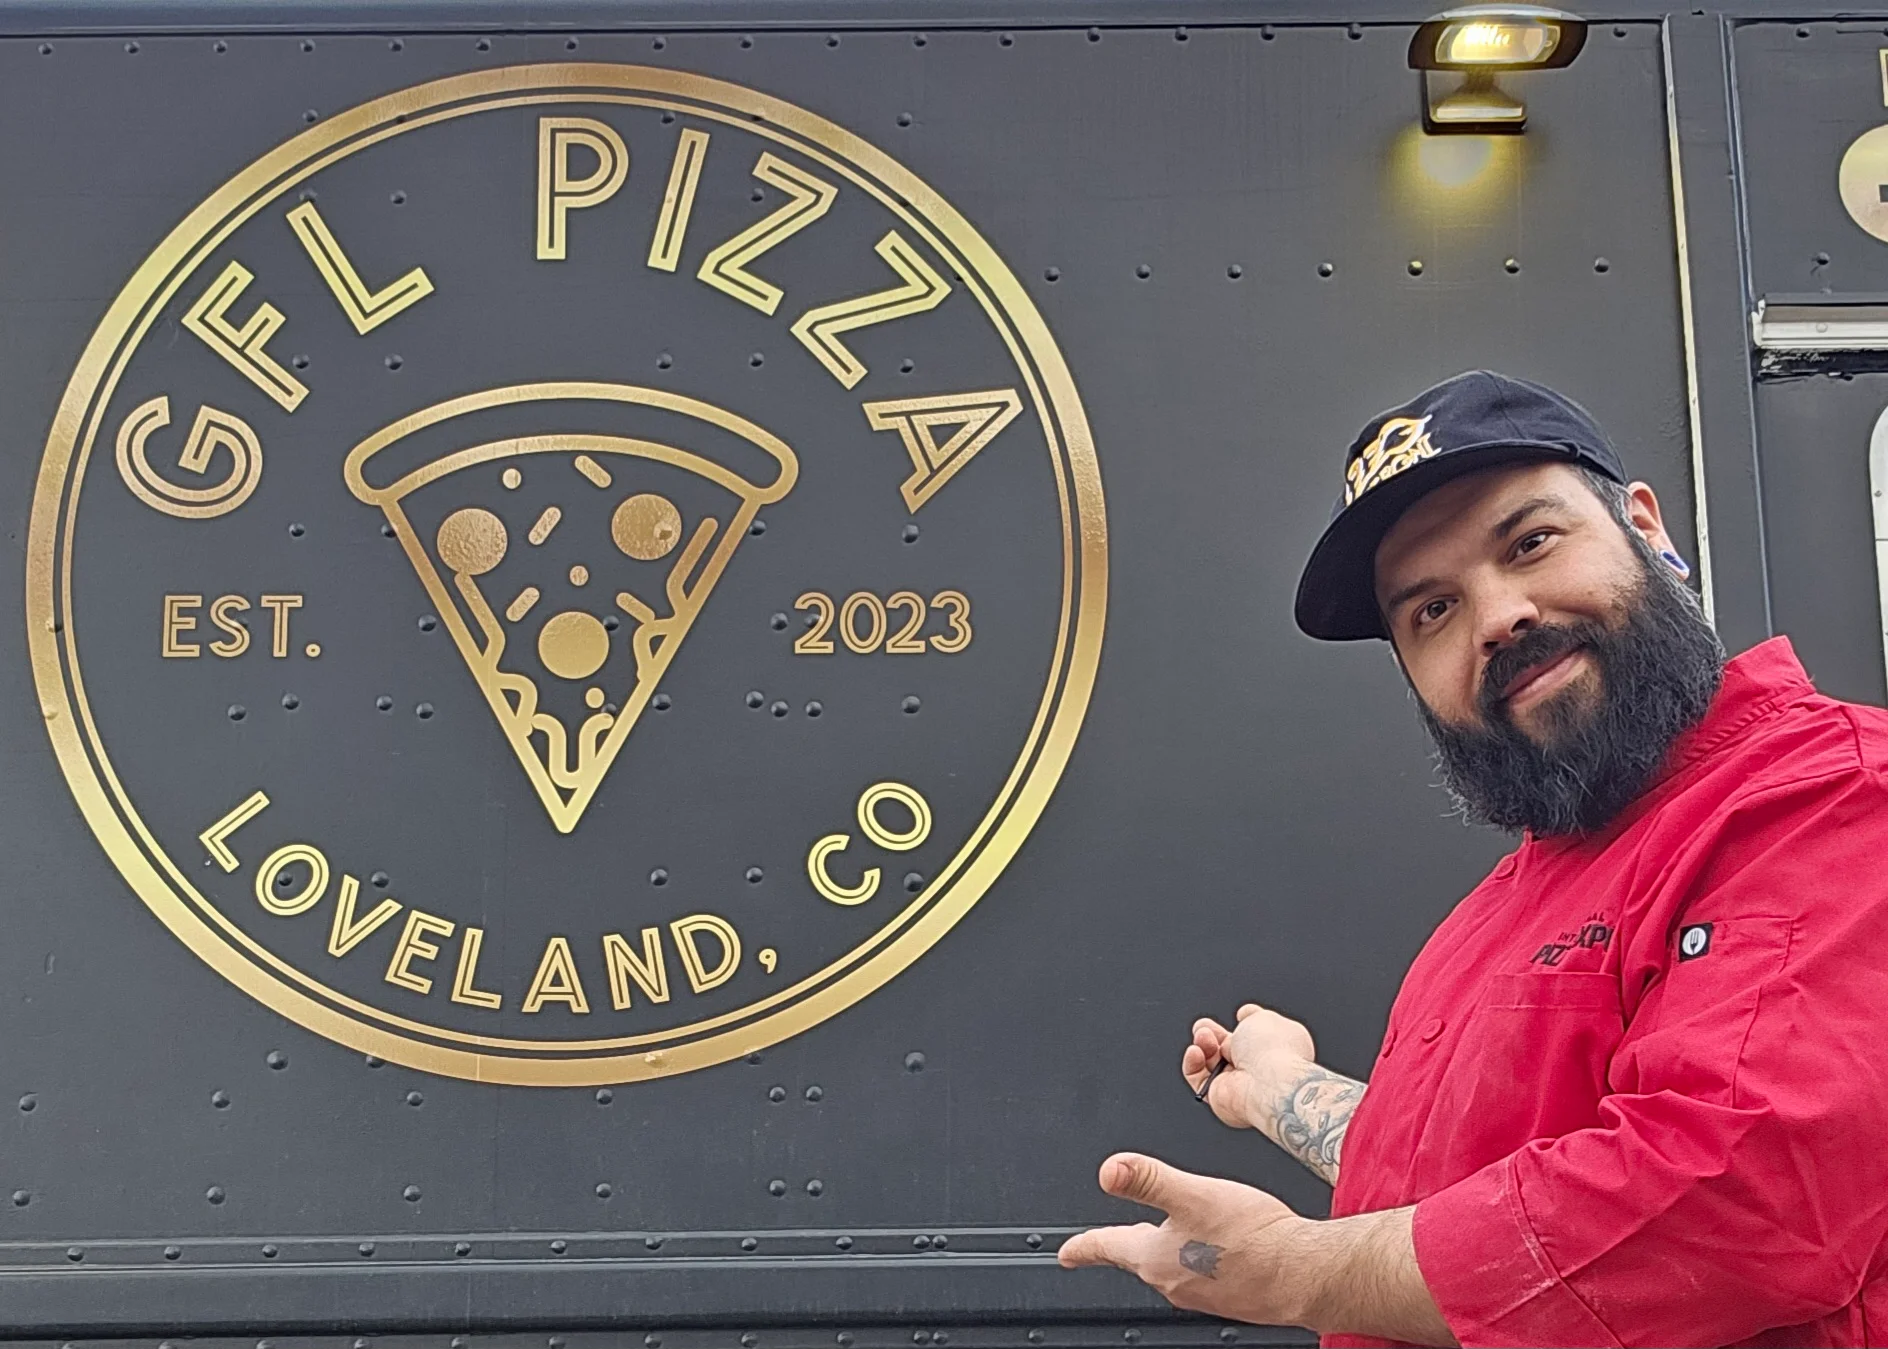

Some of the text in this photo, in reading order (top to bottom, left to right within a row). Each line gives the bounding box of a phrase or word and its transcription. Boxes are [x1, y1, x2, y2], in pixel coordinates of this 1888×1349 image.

[116, 116, 1024, 519] GFL PIZZA
[161, 594, 322, 659] EST.
[794, 590, 974, 655] 2023
[199, 782, 932, 1013] LOVELAND, CO
